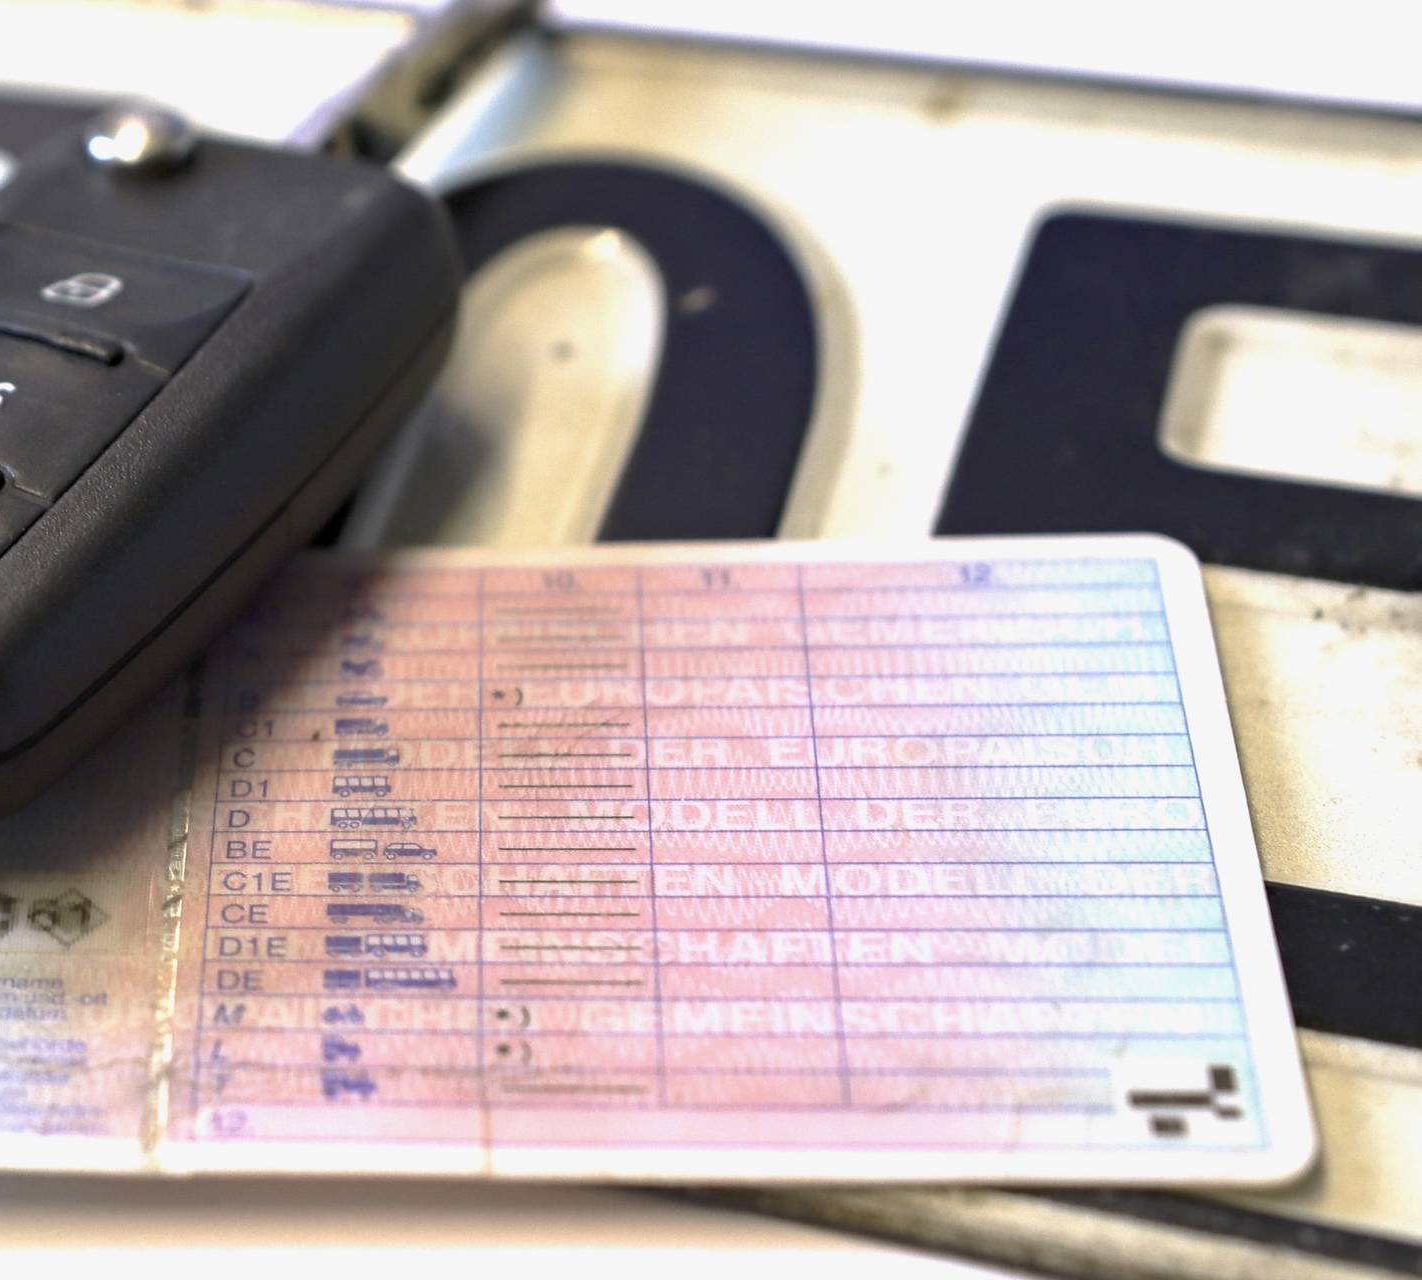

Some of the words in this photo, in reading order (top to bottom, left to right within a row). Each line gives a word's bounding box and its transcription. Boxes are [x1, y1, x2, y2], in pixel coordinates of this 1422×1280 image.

[235, 719, 275, 738] C1
[233, 748, 256, 768] C
[231, 779, 270, 798] D1
[228, 809, 250, 828] D
[568, 801, 821, 830] MODELL
[225, 840, 272, 860] BE
[223, 871, 291, 892] C1E
[220, 903, 269, 924] CE
[218, 936, 288, 958] D1E
[216, 969, 264, 990] DE
